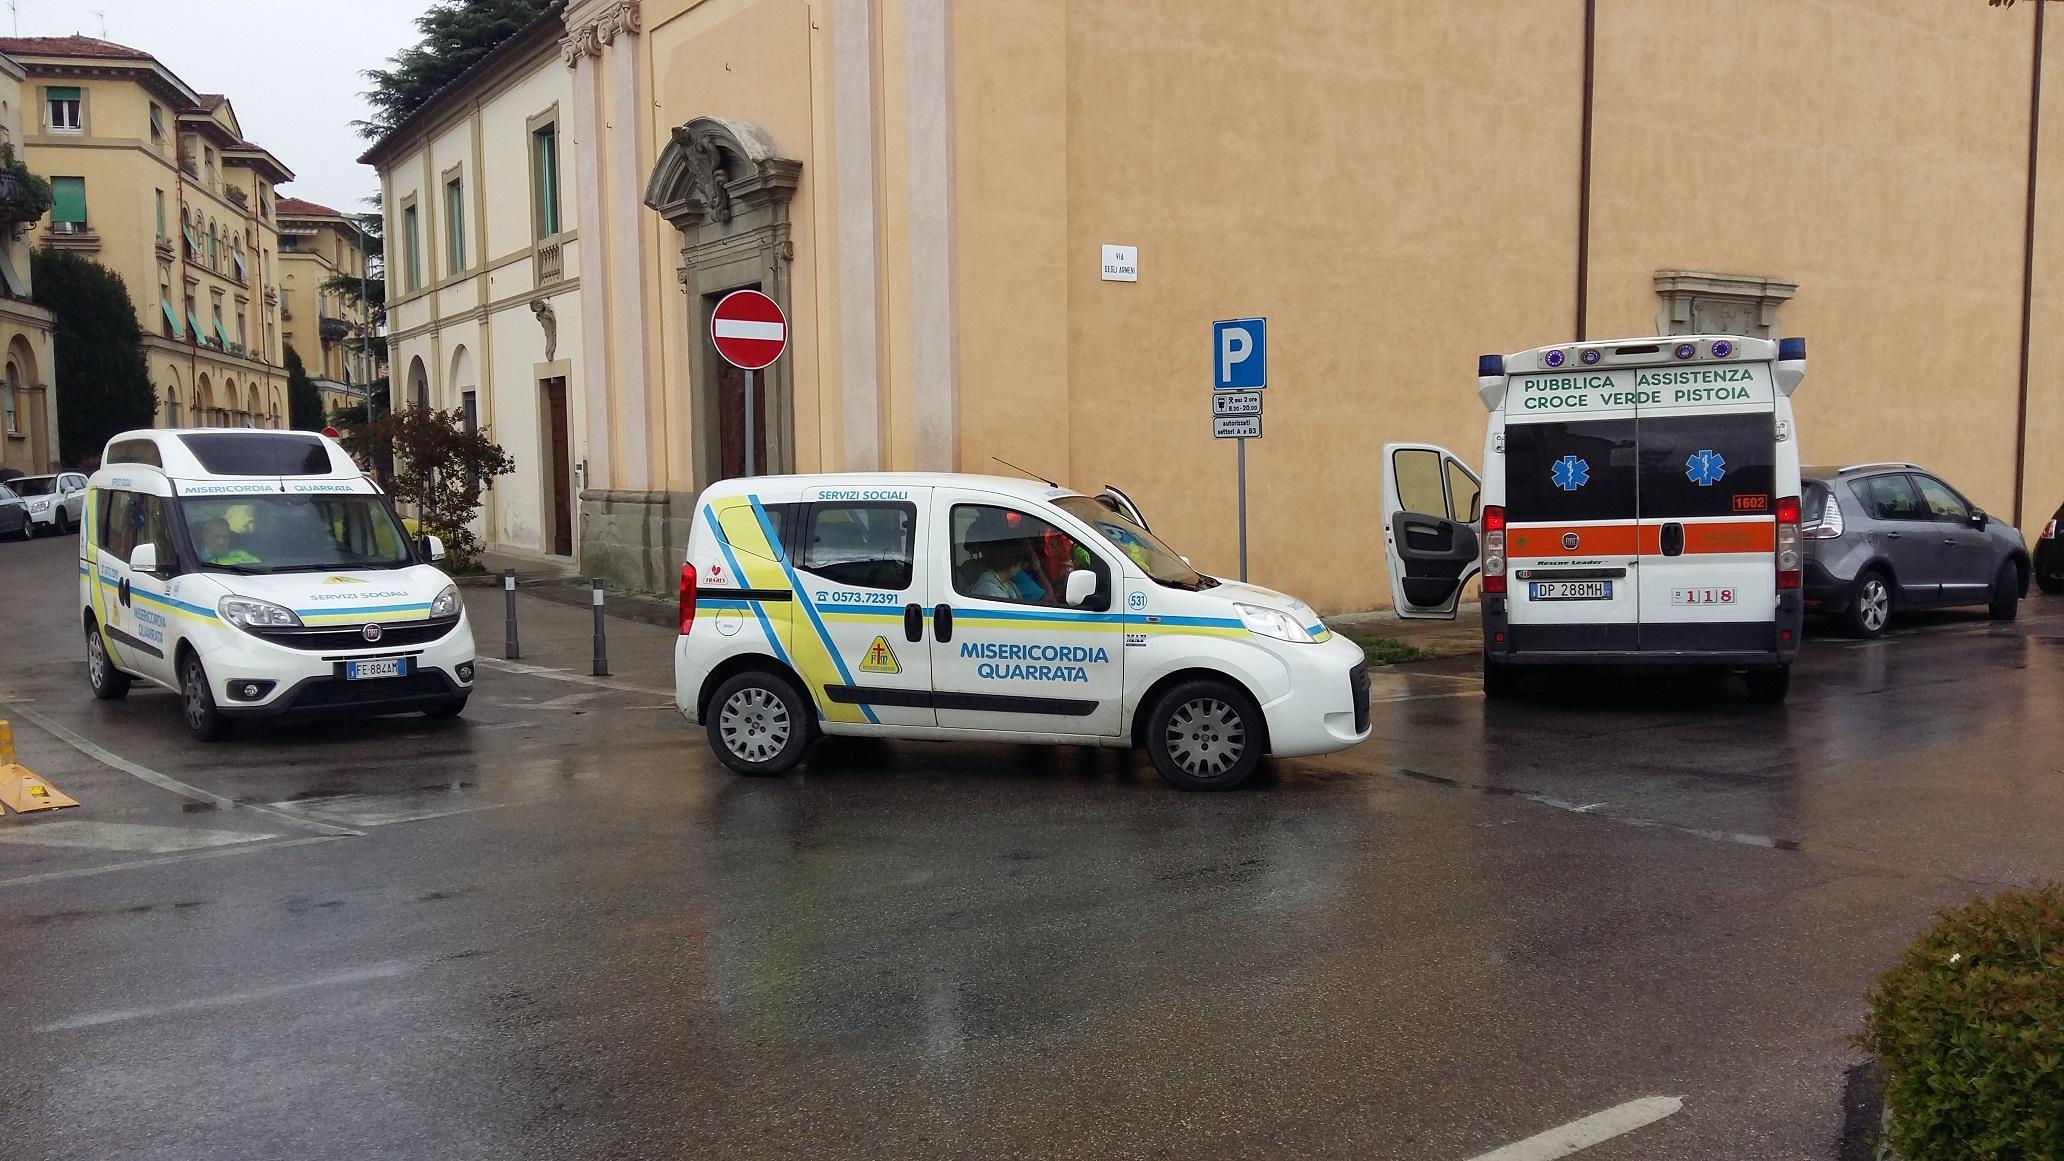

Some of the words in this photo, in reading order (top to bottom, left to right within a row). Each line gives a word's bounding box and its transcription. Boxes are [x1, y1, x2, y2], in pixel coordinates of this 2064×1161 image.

[1115, 252, 1124, 260] VIA
[1222, 327, 1253, 382] P
[1524, 375, 1615, 392] PUBBLICA
[1637, 367, 1754, 387] ASSISTENZA
[1524, 394, 1588, 410] CROCE
[1600, 390, 1662, 406] VERDE
[1674, 386, 1750, 403] PISTOIA
[185, 485, 274, 494] MISERICORDIA
[294, 484, 354, 492] QUARRATA
[818, 490, 860, 501] SERVIZI
[862, 490, 908, 501] SOCIALI
[1736, 497, 1765, 509] 1602
[1565, 537, 1576, 546] FIAT
[310, 593, 358, 601] SERVIZI
[361, 591, 409, 599] SOCIALI
[1539, 584, 1555, 597] DP
[1561, 583, 1602, 597] 288MH
[832, 591, 899, 605] 0573.72391
[1130, 595, 1145, 606] 531
[367, 628, 379, 638] FIAT
[960, 642, 1109, 664] MISERICORDIA
[977, 663, 1088, 683] QUARRATA
